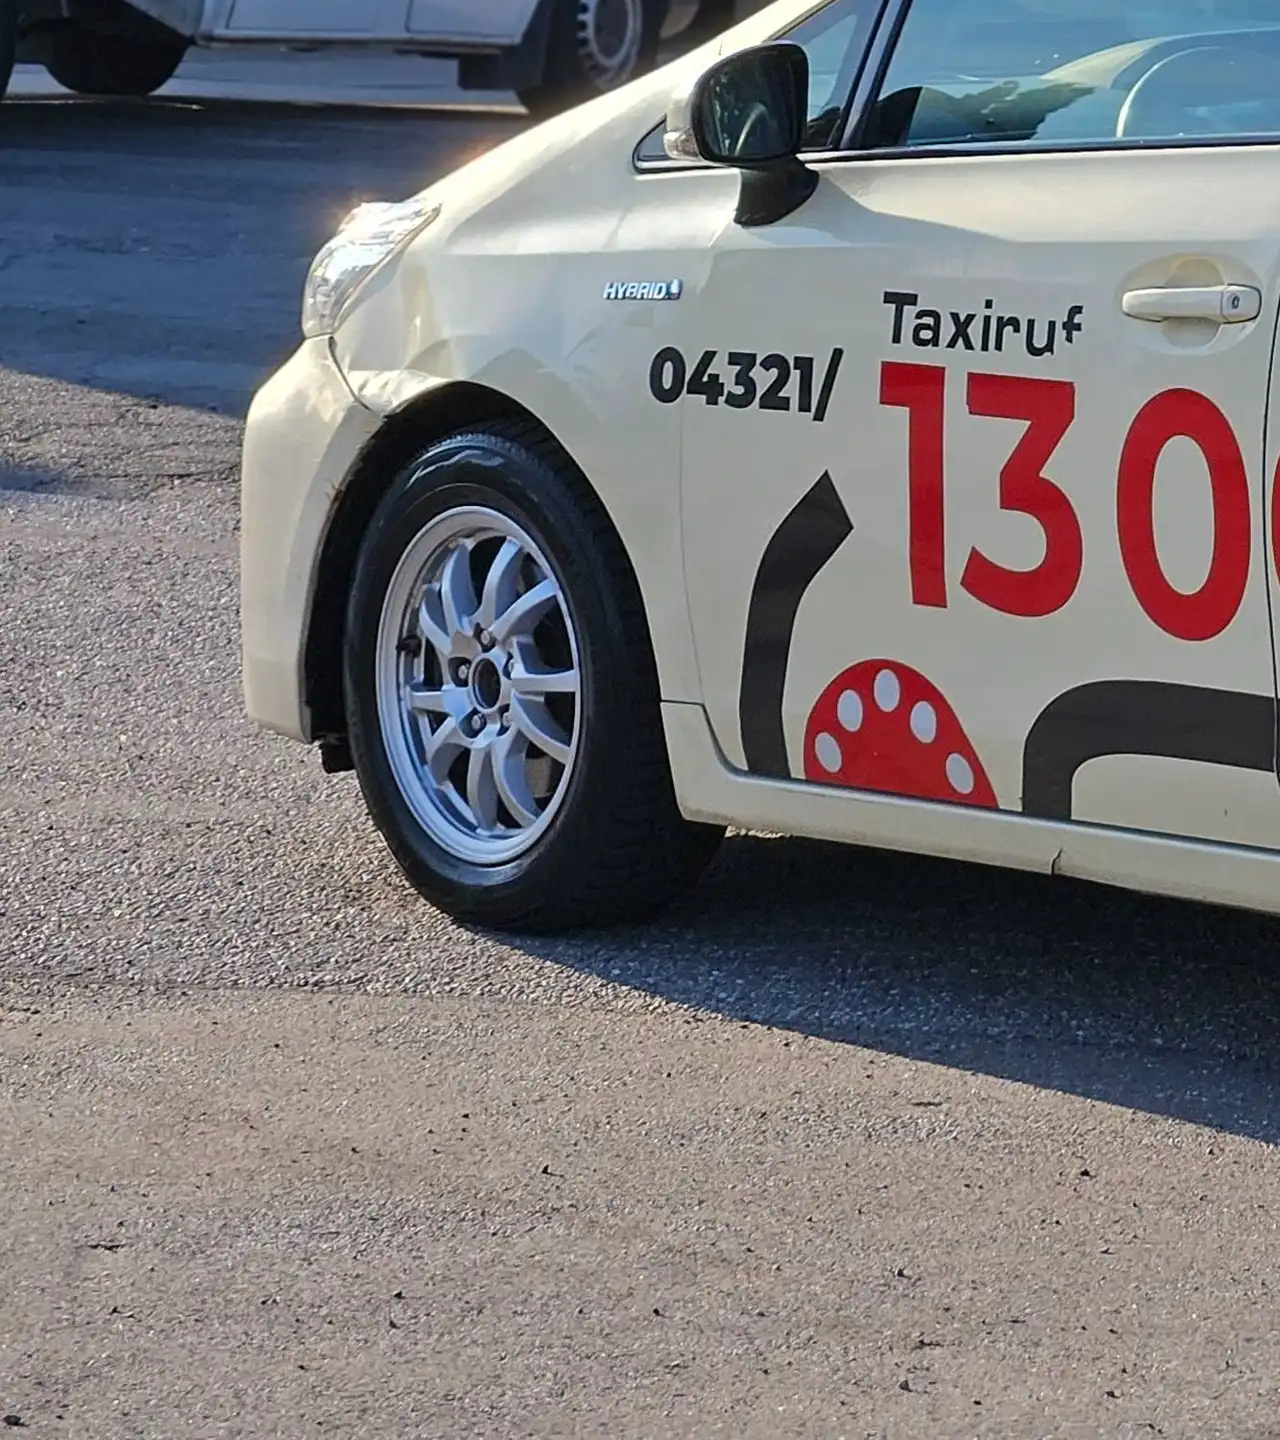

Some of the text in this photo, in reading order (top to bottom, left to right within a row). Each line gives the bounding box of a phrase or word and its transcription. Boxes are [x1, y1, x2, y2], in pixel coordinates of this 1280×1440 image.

[603, 281, 668, 300] HYBRID
[883, 291, 1084, 357] Taxiruf
[649, 346, 844, 422] 04321/
